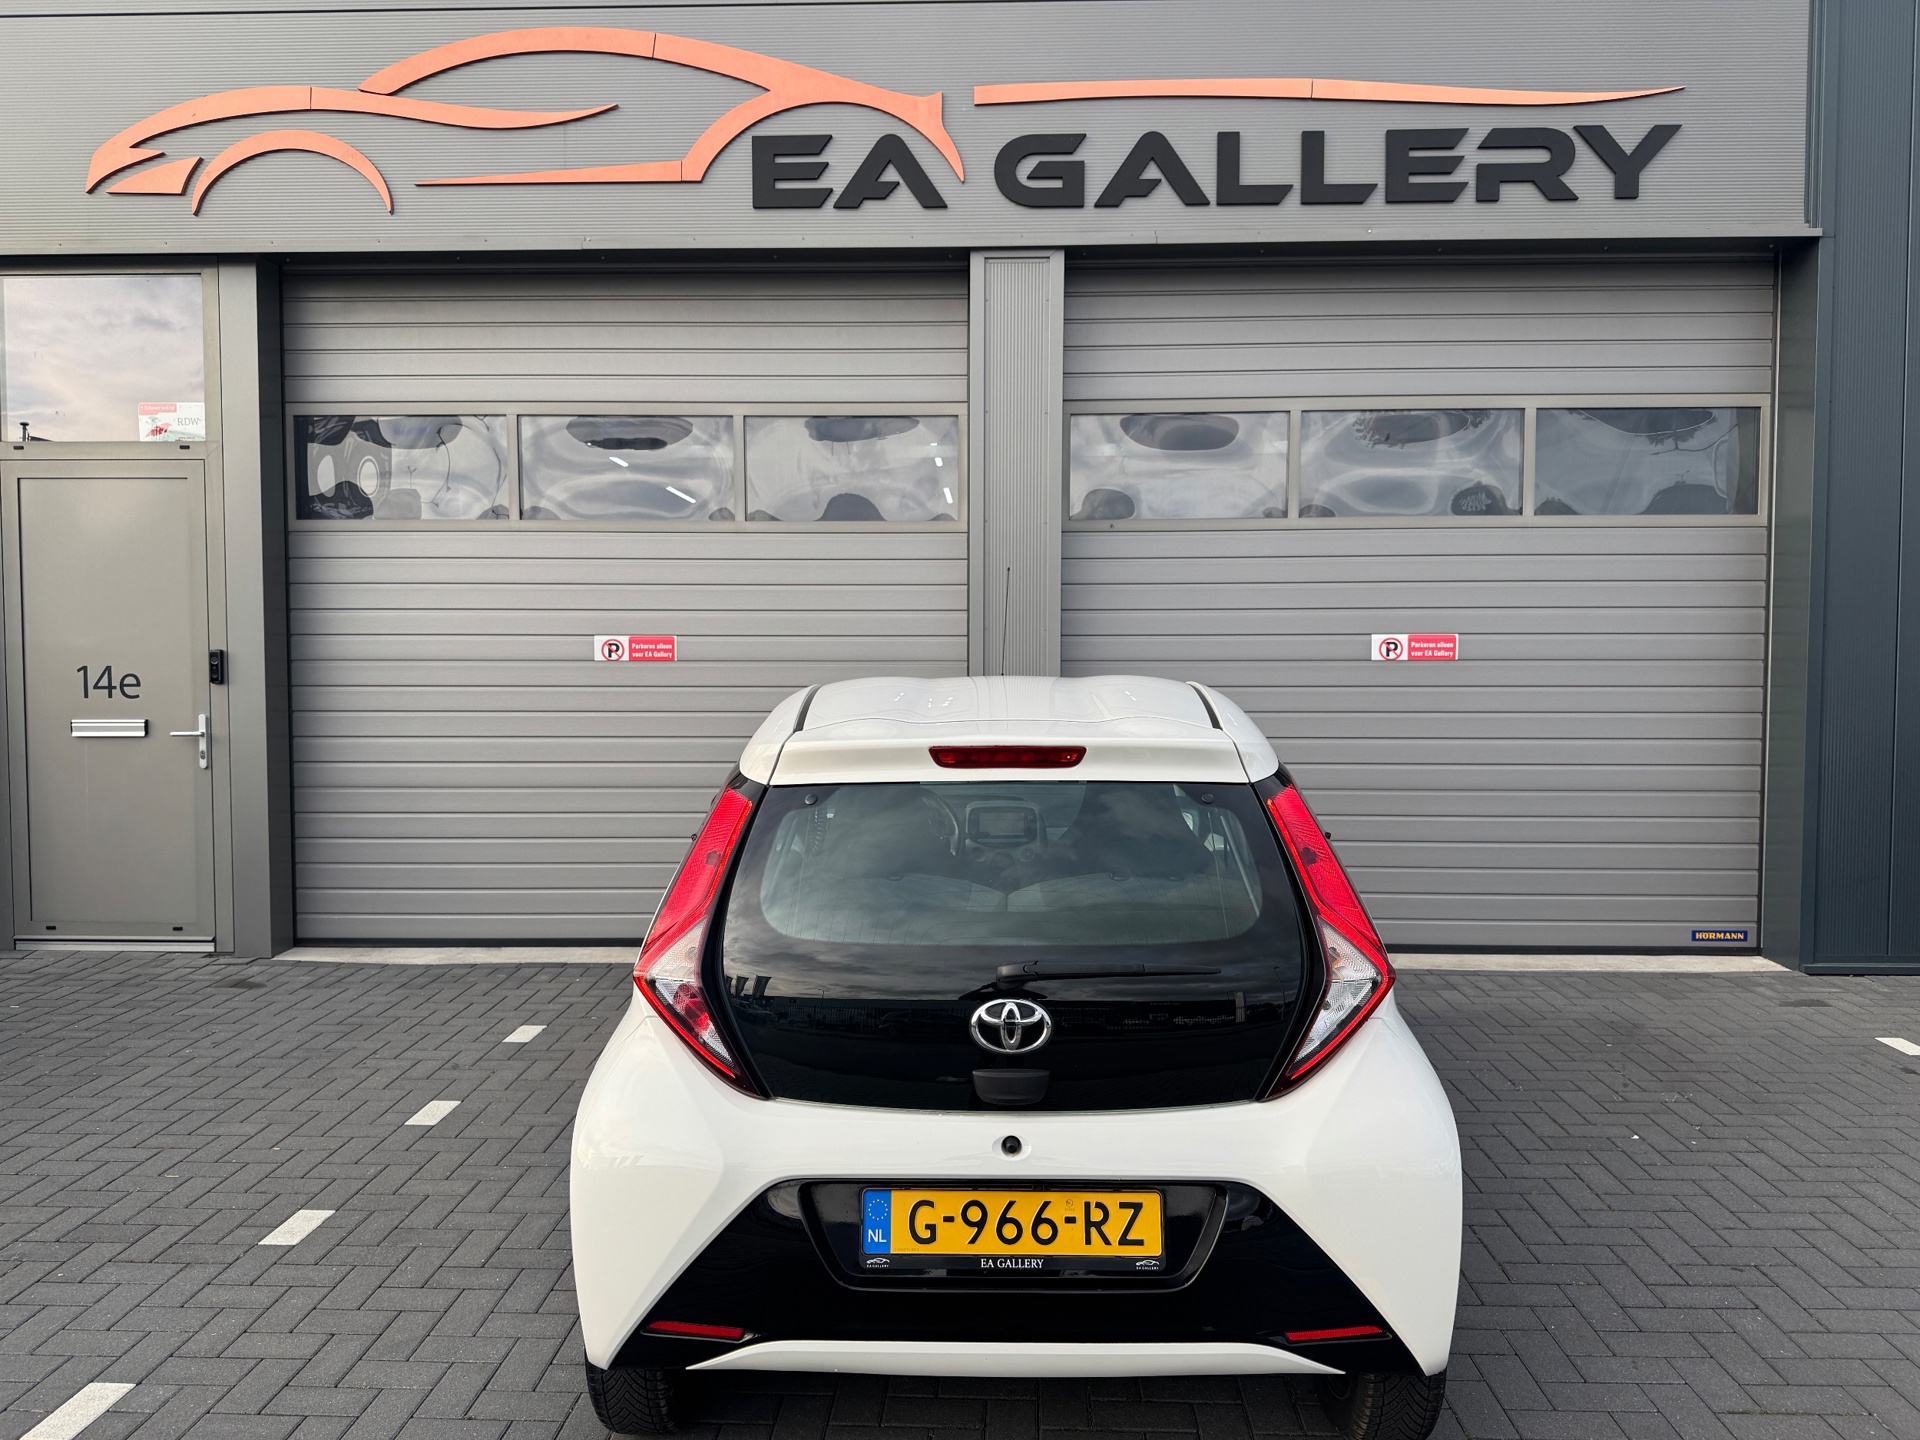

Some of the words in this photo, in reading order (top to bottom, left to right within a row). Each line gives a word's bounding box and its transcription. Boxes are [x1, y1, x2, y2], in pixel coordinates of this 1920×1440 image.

[752, 134, 948, 210] EA
[993, 124, 1683, 209] GALLERY
[177, 417, 200, 426] RDW
[653, 651, 673, 659] Gallery
[1433, 650, 1454, 658] Gallery
[77, 665, 141, 699] 14e
[908, 1199, 1145, 1247] G-966-RZ
[868, 1229, 887, 1243] NL
[981, 1258, 994, 1268] EA
[997, 1258, 1044, 1269] GALLERY
